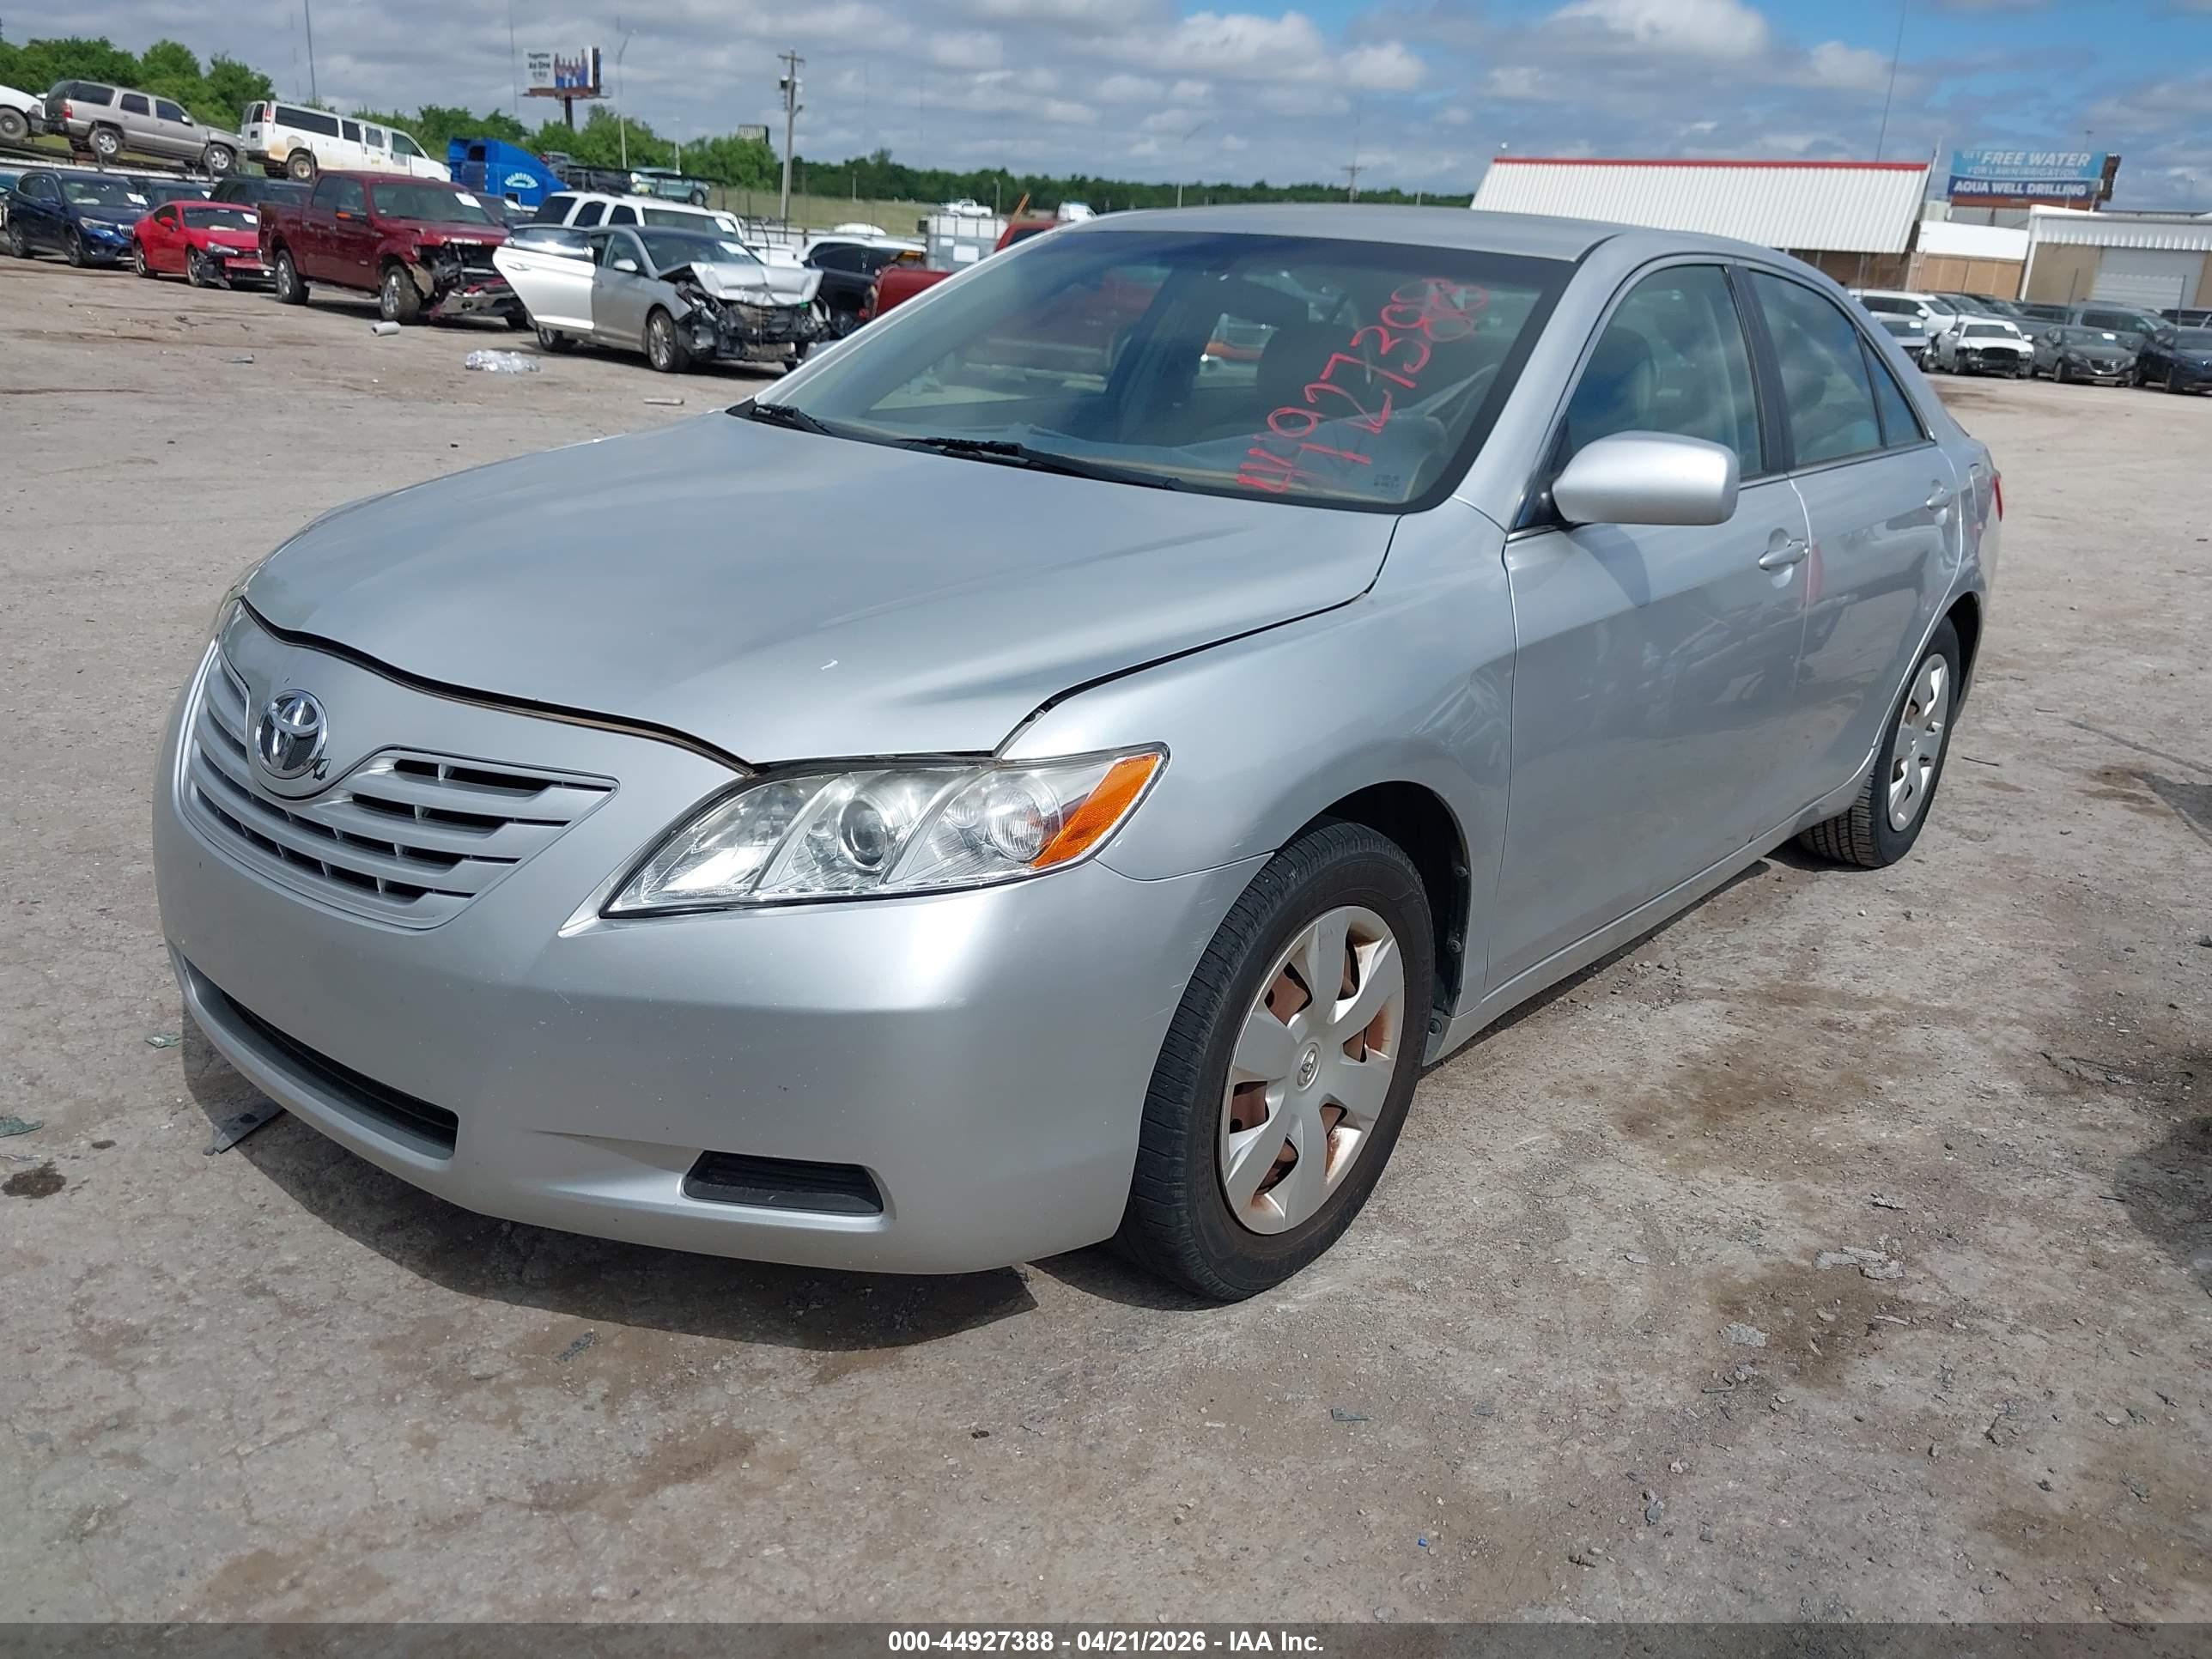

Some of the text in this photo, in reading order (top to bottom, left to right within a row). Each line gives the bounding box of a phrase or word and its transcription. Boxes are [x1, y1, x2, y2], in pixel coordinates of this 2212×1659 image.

[1982, 152, 2023, 166] FREE
[2028, 153, 2092, 167] WATER
[1967, 166, 1988, 174] FOR
[1954, 181, 2087, 197] AQUA WELL DRILLING
